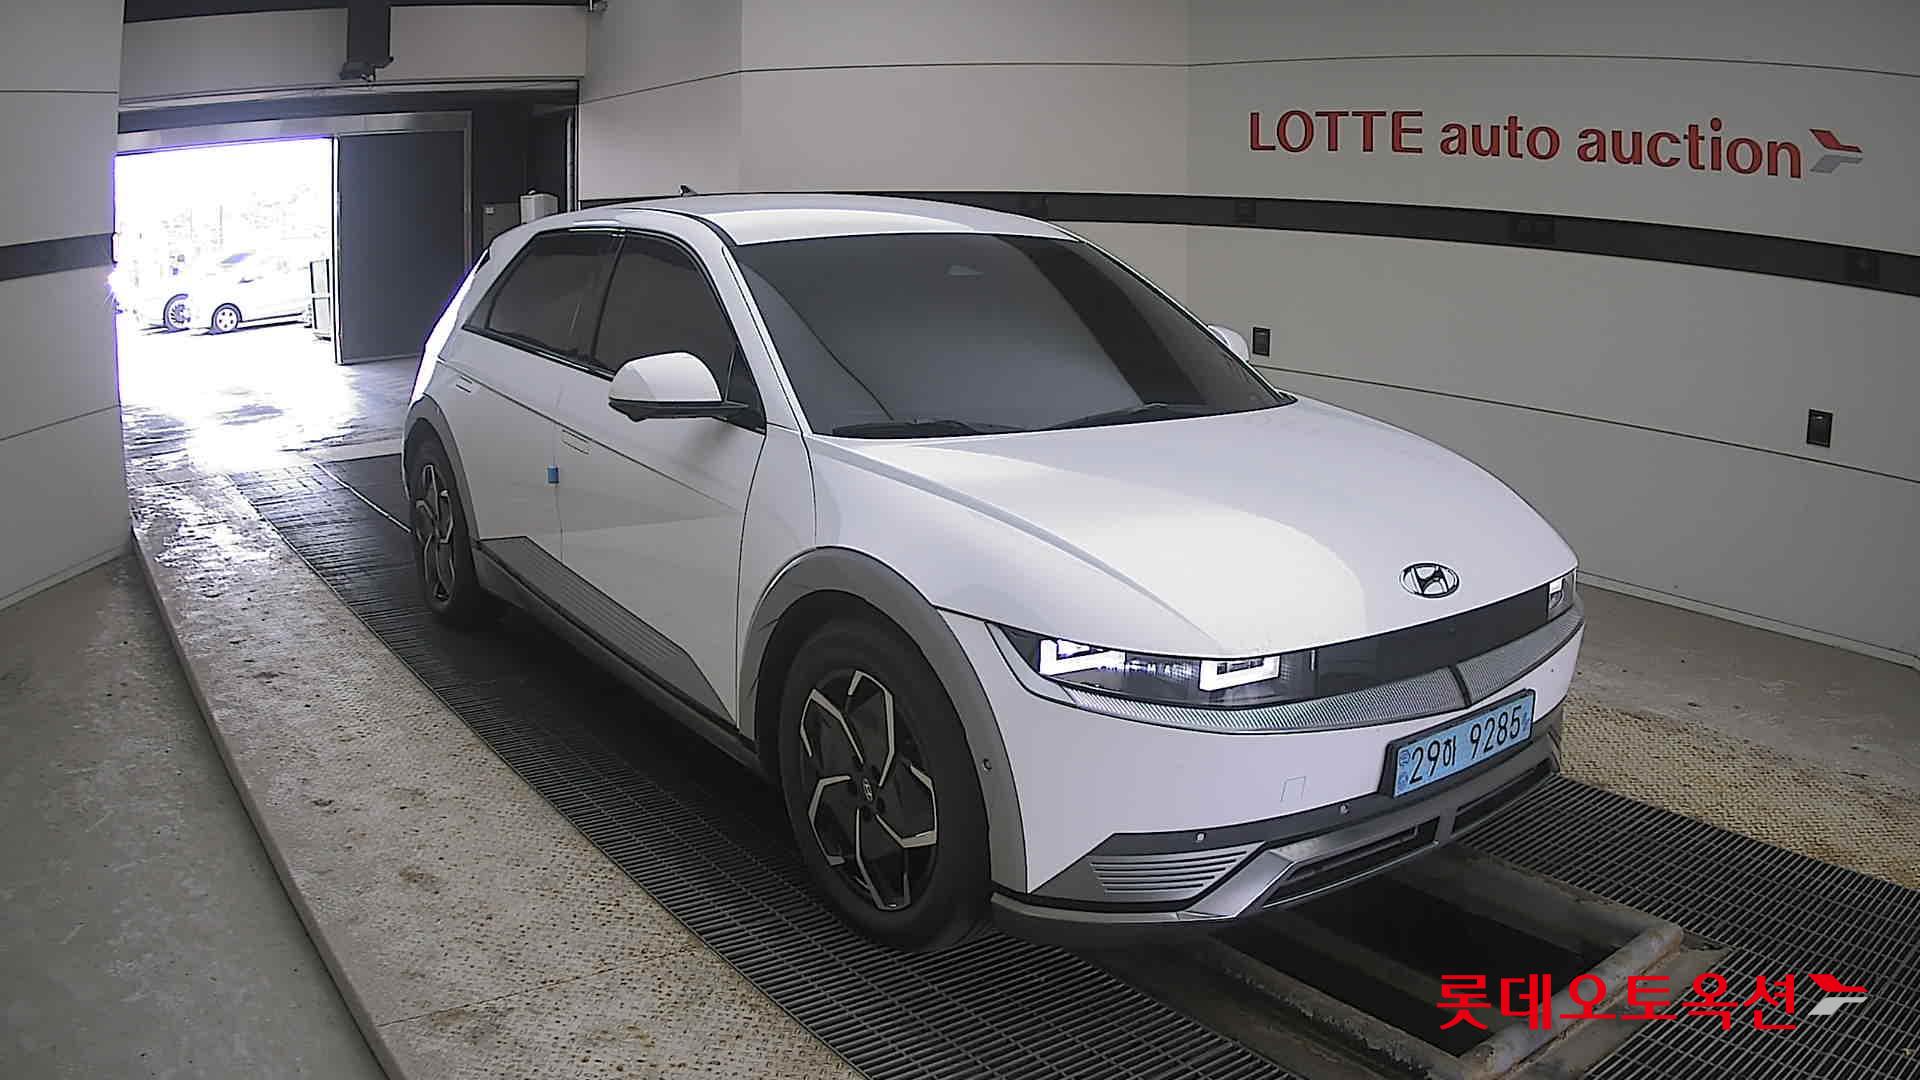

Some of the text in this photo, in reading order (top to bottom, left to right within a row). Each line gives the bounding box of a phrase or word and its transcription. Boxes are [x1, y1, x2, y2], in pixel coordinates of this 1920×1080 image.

[1249, 110, 1803, 180] LOTTE auto auction
[1470, 704, 1523, 760] 9285
